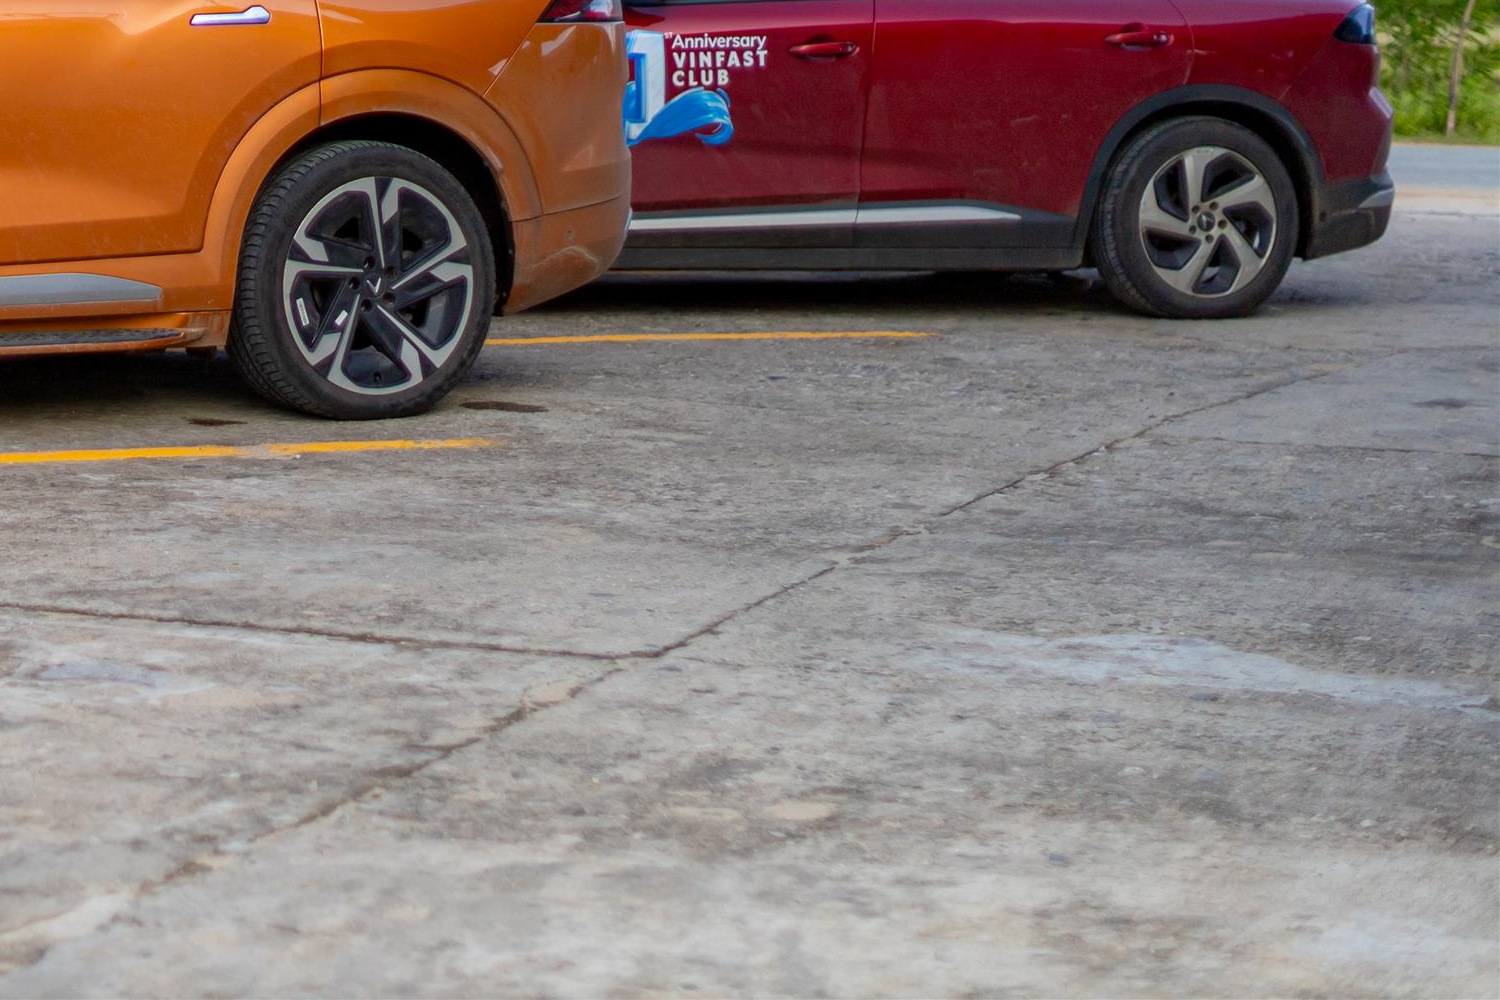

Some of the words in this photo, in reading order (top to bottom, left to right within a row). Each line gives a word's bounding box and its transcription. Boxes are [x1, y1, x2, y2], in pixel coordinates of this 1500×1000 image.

[671, 33, 767, 50] Anniversary
[672, 50, 768, 67] VINFAST
[672, 69, 729, 86] CLUB
